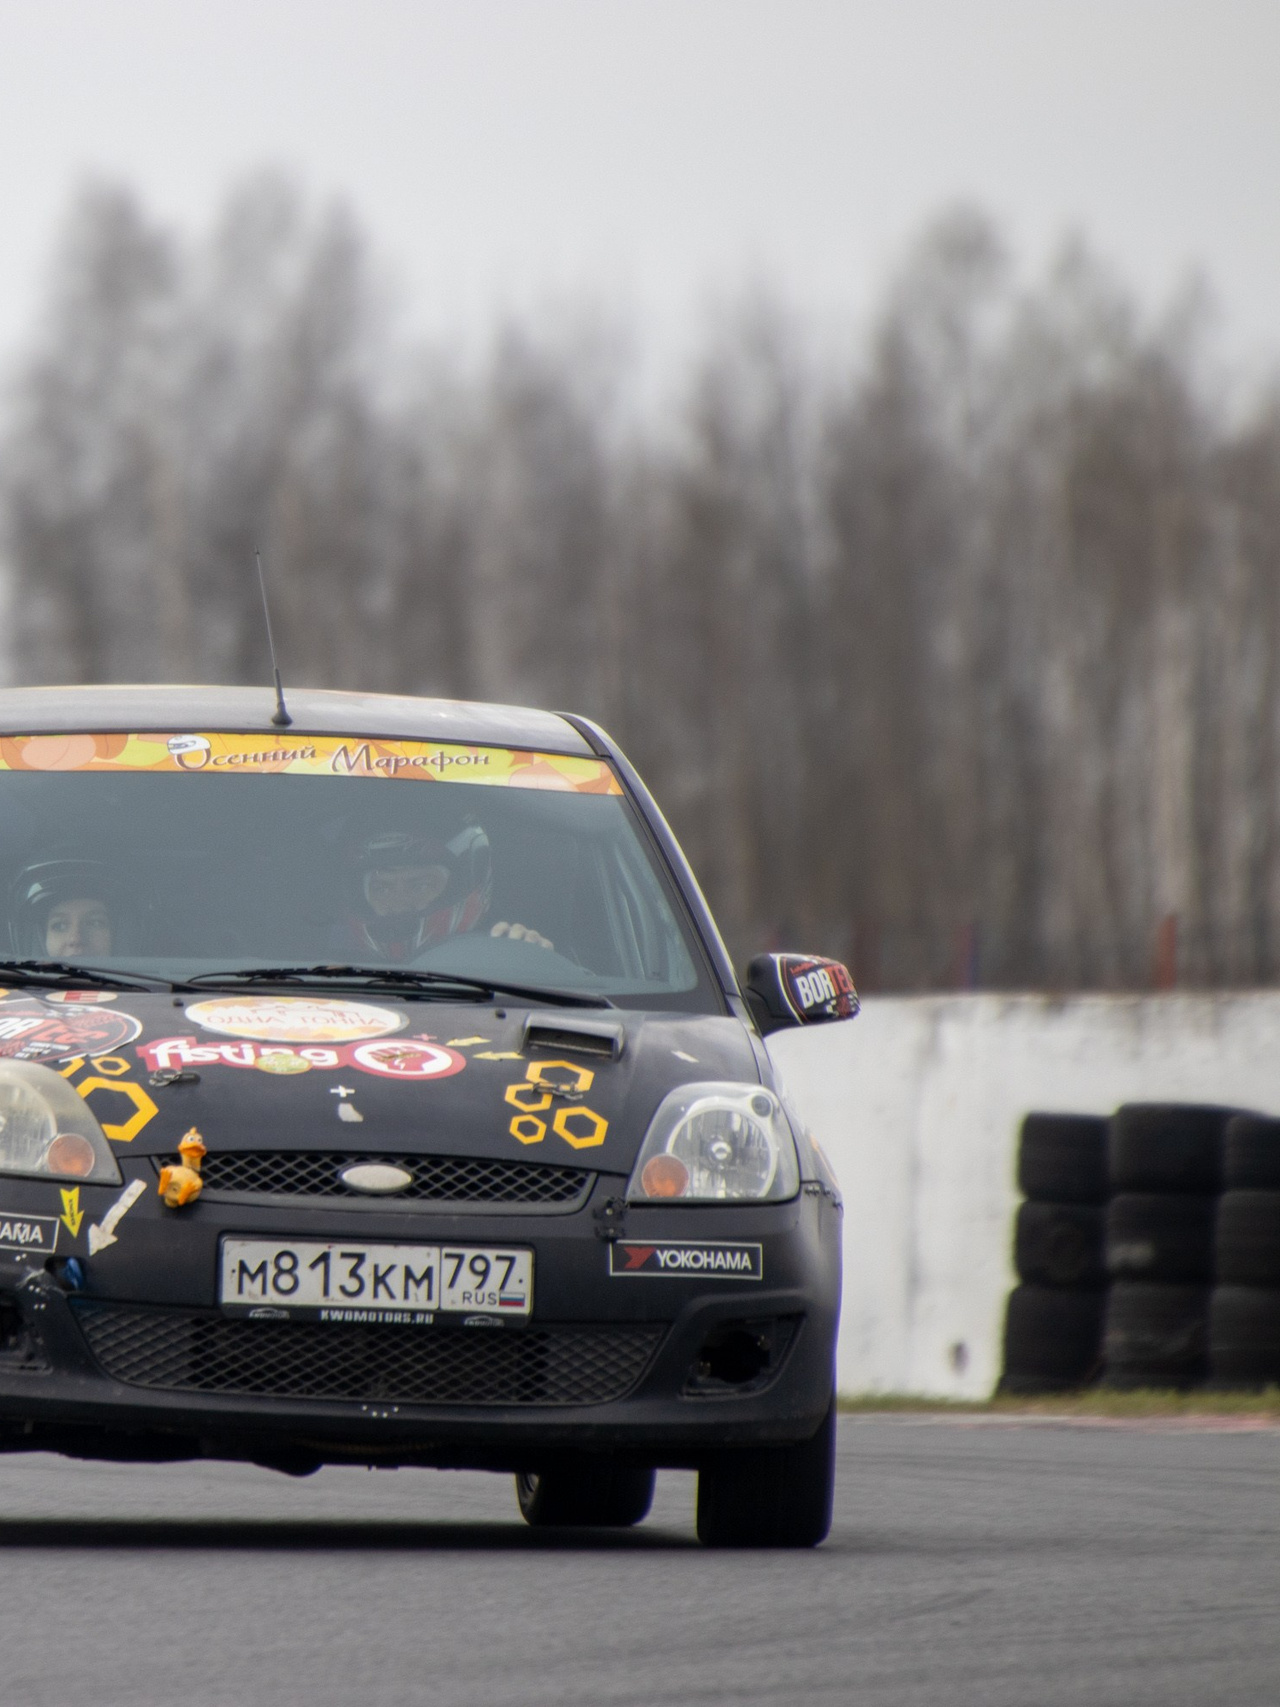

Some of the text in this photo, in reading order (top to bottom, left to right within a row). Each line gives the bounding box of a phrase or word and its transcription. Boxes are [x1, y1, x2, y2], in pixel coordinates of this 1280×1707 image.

[174, 743, 490, 775] Осенний Марафон
[443, 1252, 518, 1292] 797
[655, 1249, 753, 1271] YOKOHAMA
[461, 1290, 498, 1306] RUS
